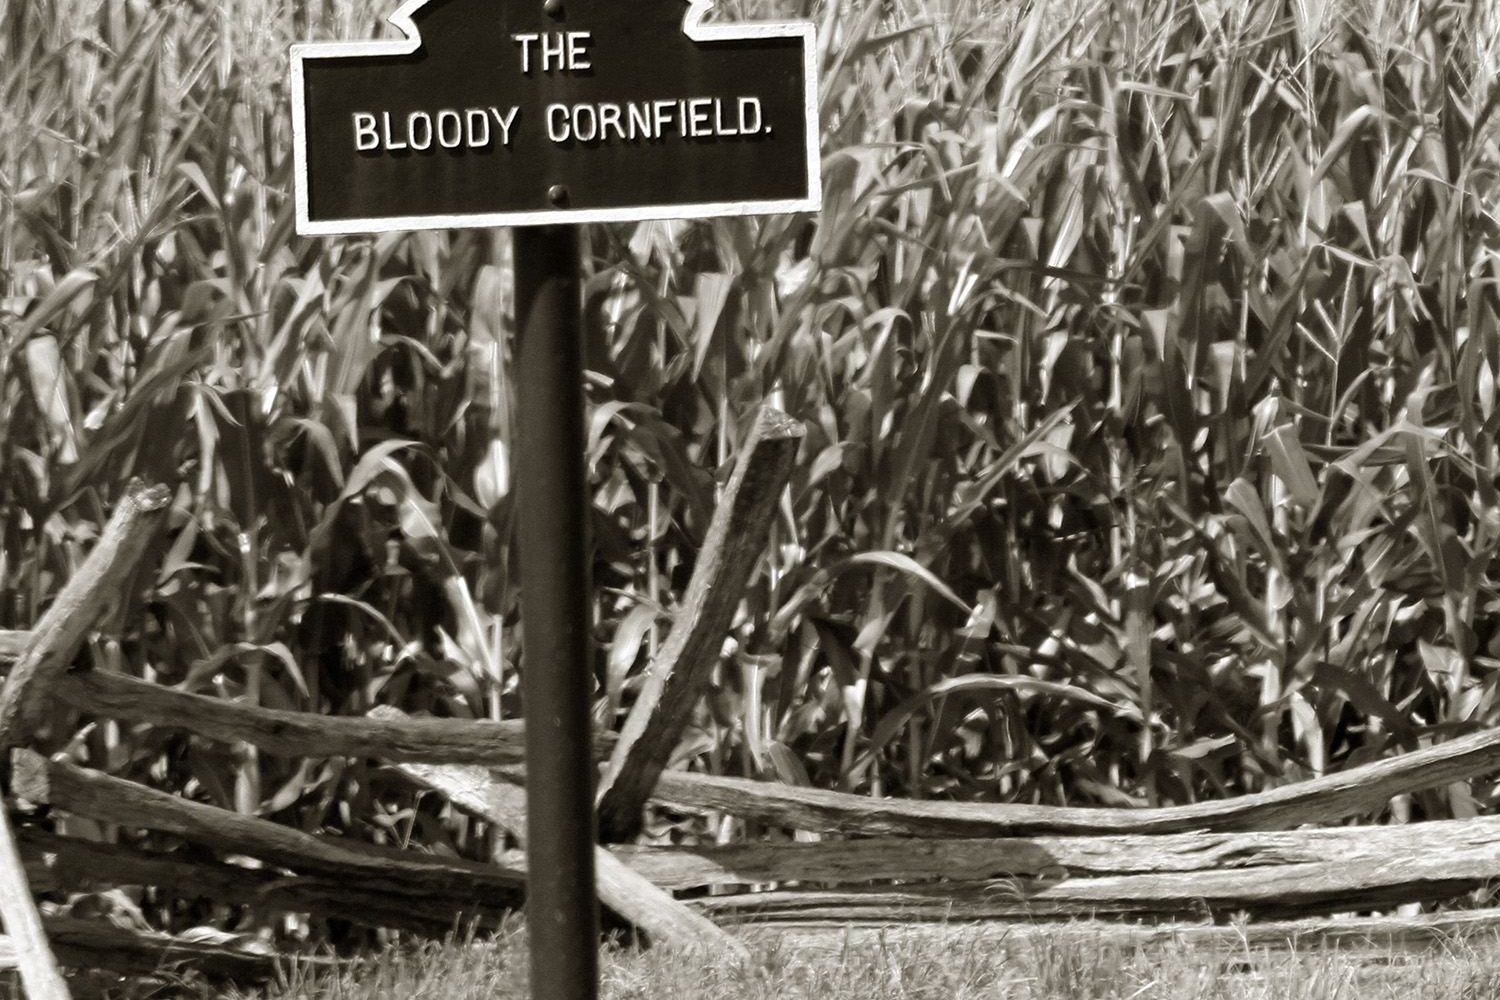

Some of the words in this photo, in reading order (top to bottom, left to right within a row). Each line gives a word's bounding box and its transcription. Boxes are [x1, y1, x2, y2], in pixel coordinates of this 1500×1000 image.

[512, 31, 591, 73] THE
[352, 105, 520, 151] BLOODY
[544, 96, 774, 143] CORNFIELD.
